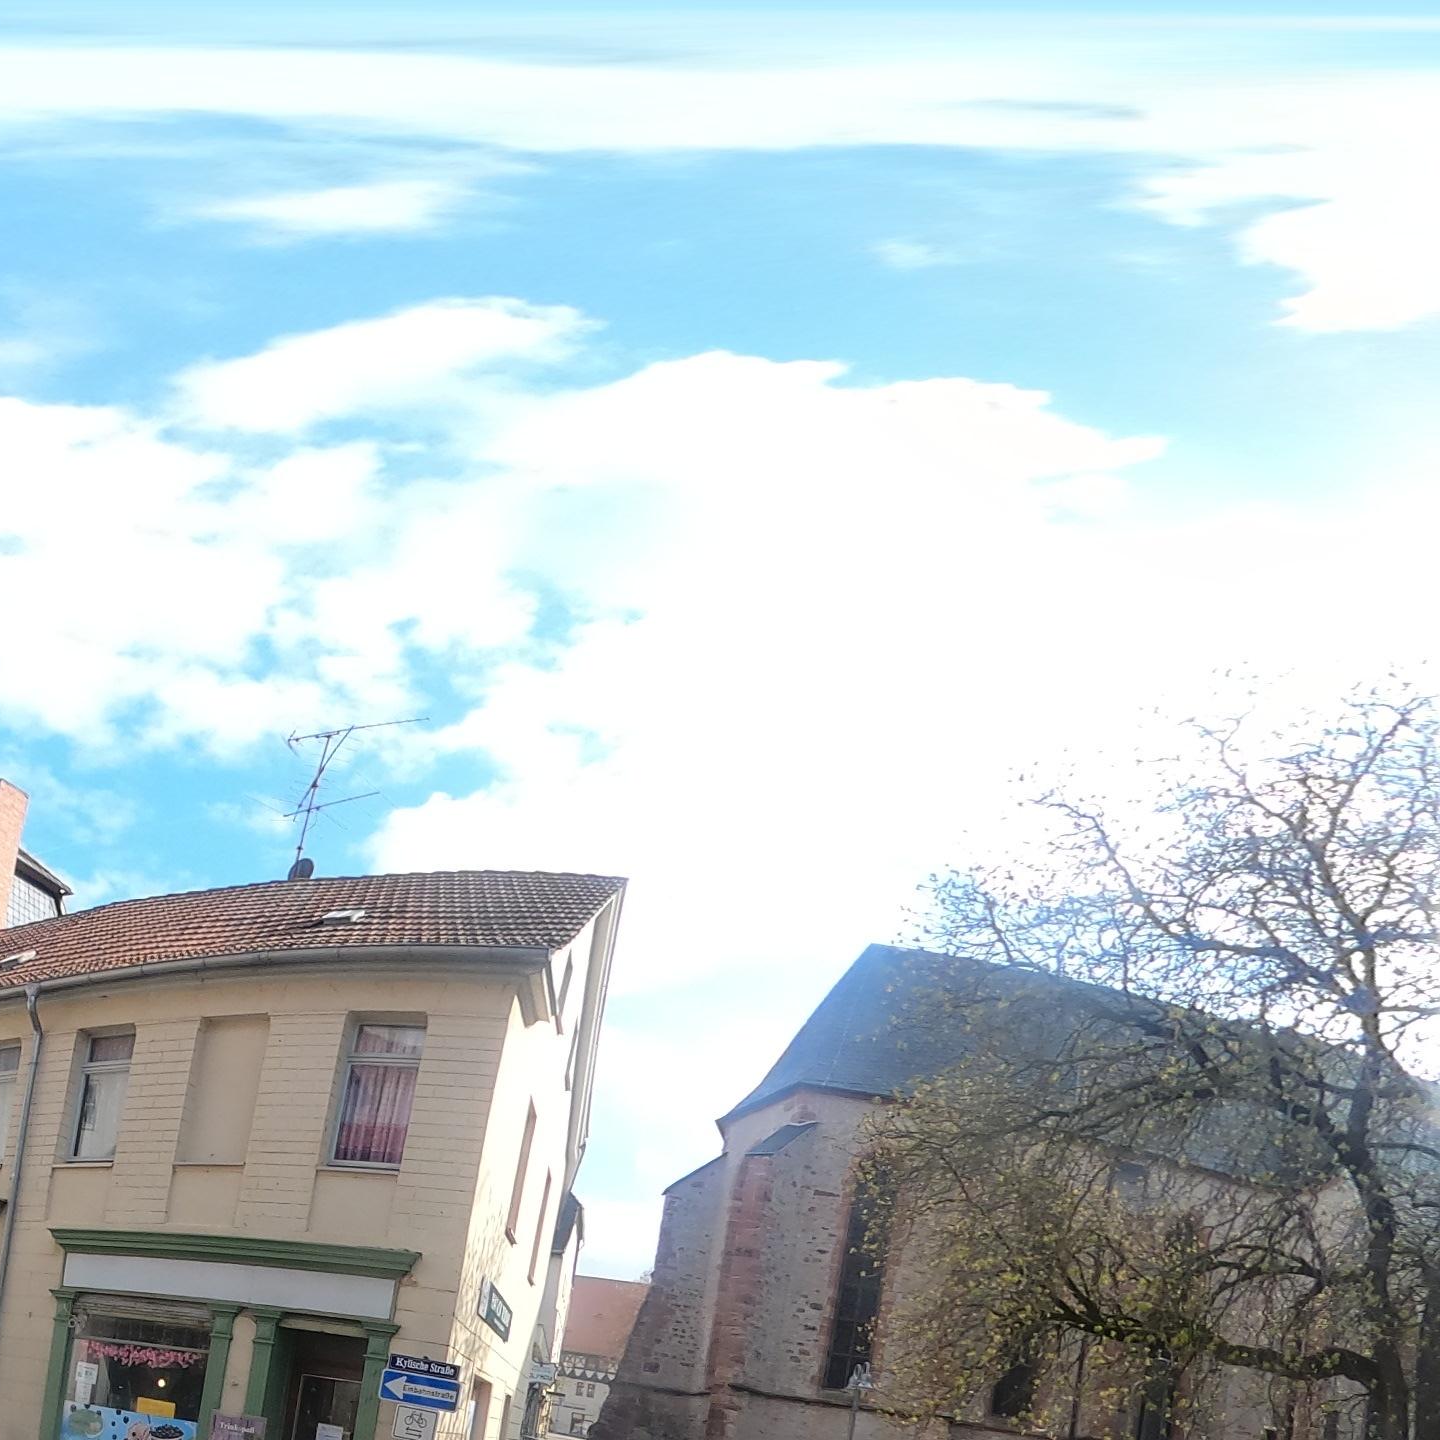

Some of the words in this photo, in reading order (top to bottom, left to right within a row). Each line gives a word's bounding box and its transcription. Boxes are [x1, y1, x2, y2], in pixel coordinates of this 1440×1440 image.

[395, 1357, 429, 1371] Kylische
[429, 1363, 455, 1376] Straße
[403, 1384, 455, 1399] Einbahnstraße
